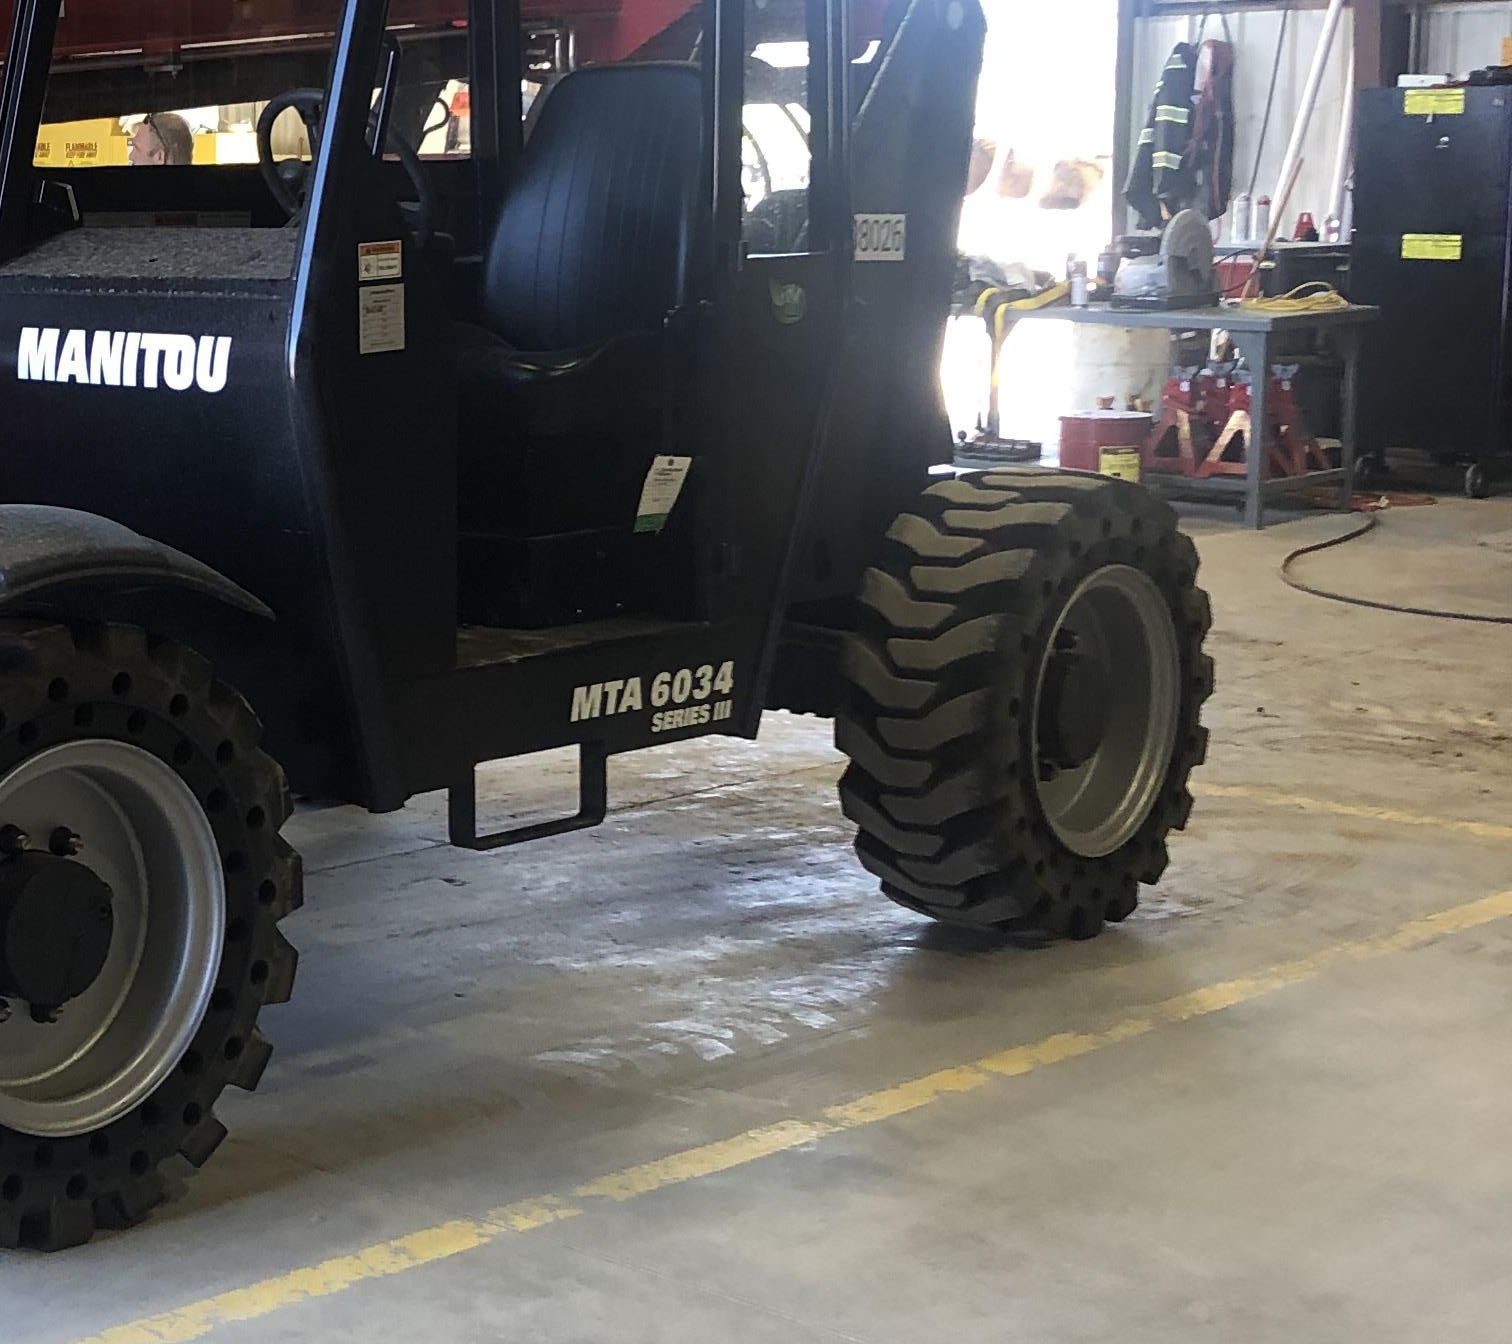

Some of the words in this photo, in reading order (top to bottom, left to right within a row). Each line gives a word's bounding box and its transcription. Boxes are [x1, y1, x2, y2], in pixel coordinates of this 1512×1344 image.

[65, 142, 98, 152] FLAMMABLE
[17, 326, 233, 393] MANITOU
[570, 677, 643, 723] MTA
[650, 660, 735, 707] 6034
[651, 703, 712, 733] SERIES
[712, 699, 733, 721] III
